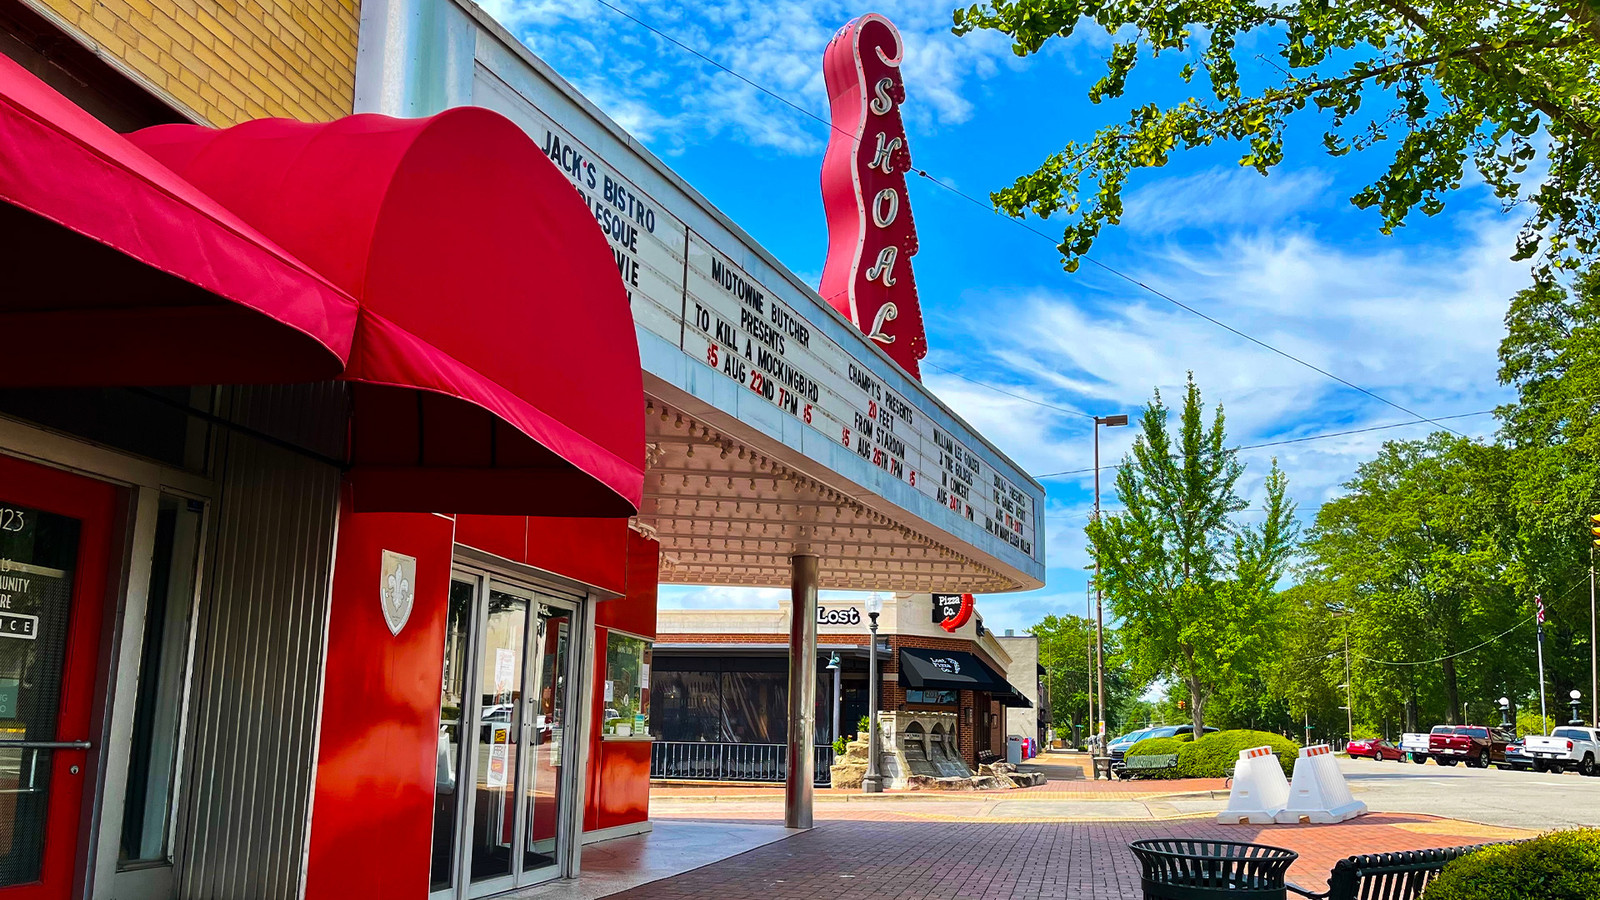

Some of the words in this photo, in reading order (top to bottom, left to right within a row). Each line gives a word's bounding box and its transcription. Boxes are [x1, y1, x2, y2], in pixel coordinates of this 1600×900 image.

[541, 131, 597, 190] JACK'S
[603, 174, 656, 234] BISTRO
[572, 184, 638, 255] ESQUE
[866, 78, 902, 344] SHOAL
[609, 245, 640, 288] VIE
[711, 257, 764, 315] MIDTOWNE
[771, 302, 810, 349] BUTCHER
[740, 307, 785, 356] PRESENTS
[695, 303, 710, 333] TO
[716, 317, 739, 351] KILL
[745, 338, 752, 362] A
[757, 346, 819, 403] MOCKINGBIRD
[707, 343, 719, 369] $5
[723, 353, 746, 384] AUG
[749, 369, 775, 401] 22ND
[778, 387, 798, 416] 7PM
[803, 403, 813, 425] $5
[848, 363, 882, 402] CHAMPY'S
[885, 390, 913, 425] PRESENTS
[854, 411, 873, 439] FROM
[868, 400, 878, 420] 20
[879, 407, 894, 433] FEET
[841, 427, 851, 447] $5
[857, 437, 871, 460] AUG
[872, 447, 889, 471] 26TH
[890, 457, 903, 480] 7PM
[933, 428, 954, 456] WILLIAM
[954, 443, 963, 462] LEE
[944, 454, 954, 474] THE
[936, 487, 948, 505] AUG
[950, 477, 970, 501] CONCERT
[0, 575, 30, 593] UNITY
[0, 593, 12, 609] RE
[938, 595, 961, 606] Pizza
[817, 606, 860, 625] Lost
[944, 606, 956, 616] Co.
